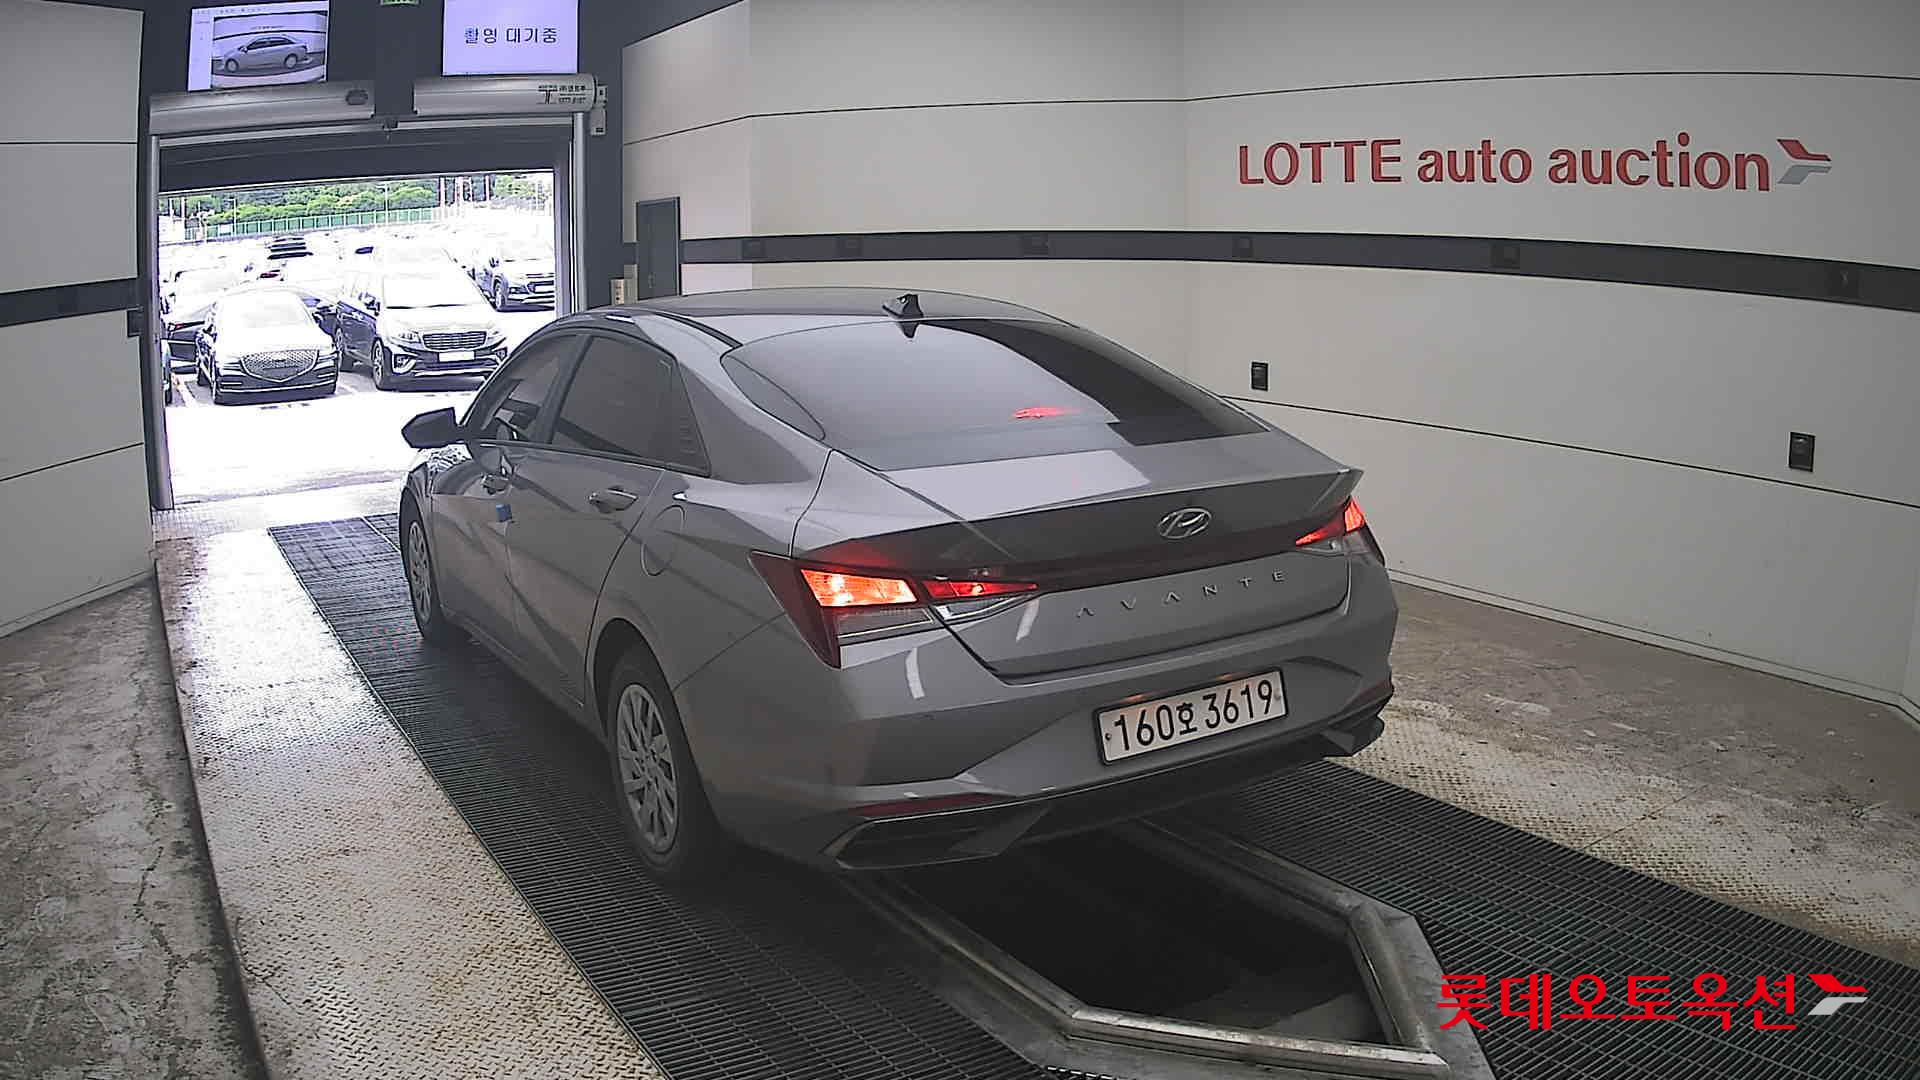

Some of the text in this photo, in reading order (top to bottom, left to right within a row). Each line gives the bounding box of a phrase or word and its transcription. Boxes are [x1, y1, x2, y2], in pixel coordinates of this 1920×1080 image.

[505, 27, 558, 43] 대기중
[1238, 131, 1771, 192] LOTTE auto auction
[1076, 568, 1286, 619] AVANTE
